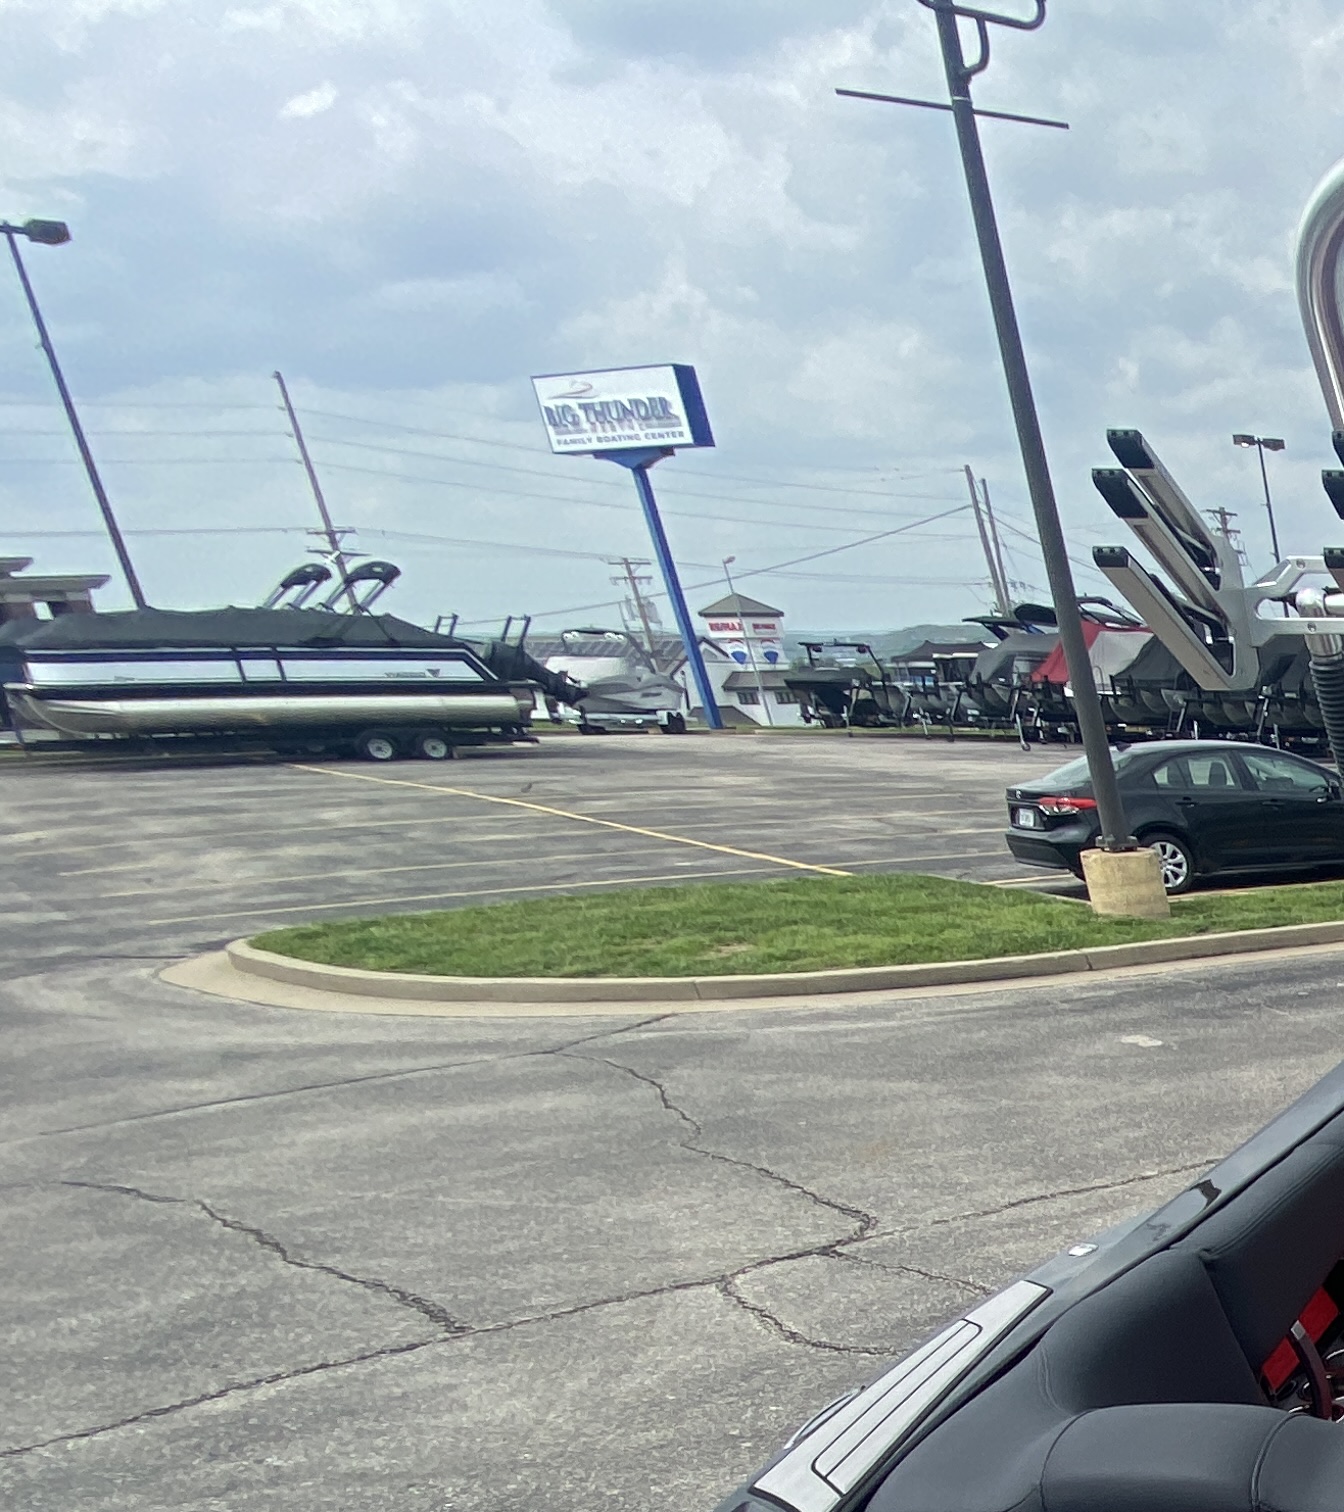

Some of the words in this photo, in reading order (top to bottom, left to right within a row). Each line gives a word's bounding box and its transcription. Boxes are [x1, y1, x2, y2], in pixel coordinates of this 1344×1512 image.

[543, 403, 580, 428] BIG
[577, 396, 681, 425] THUNDER
[556, 435, 593, 446] FAMILY
[596, 433, 642, 443] BOATING
[644, 430, 685, 440] CENTER
